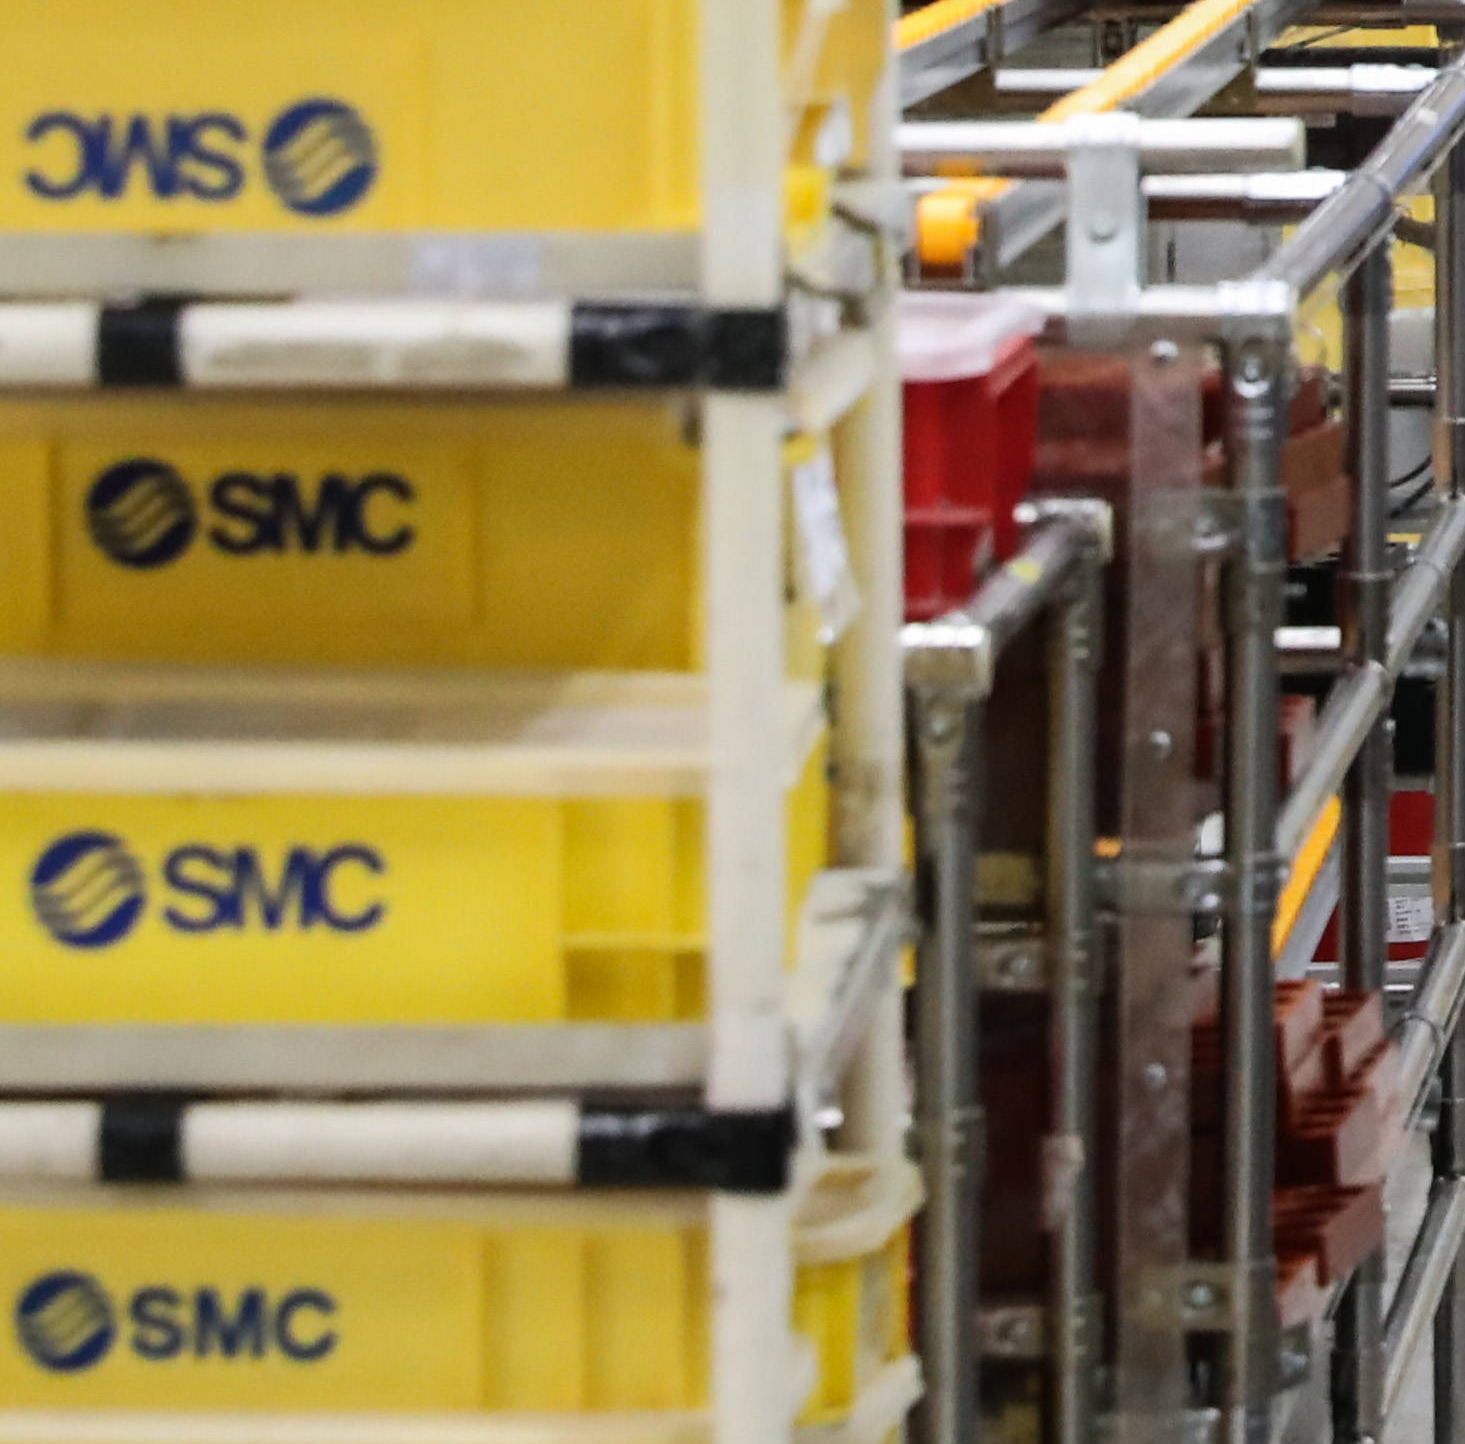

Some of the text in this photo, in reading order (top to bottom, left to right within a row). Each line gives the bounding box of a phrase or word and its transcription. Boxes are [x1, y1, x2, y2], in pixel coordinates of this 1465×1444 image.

[26, 113, 247, 201] SMC
[209, 472, 415, 555] SMC
[162, 844, 388, 934] SMC
[129, 1288, 339, 1361] SMC
